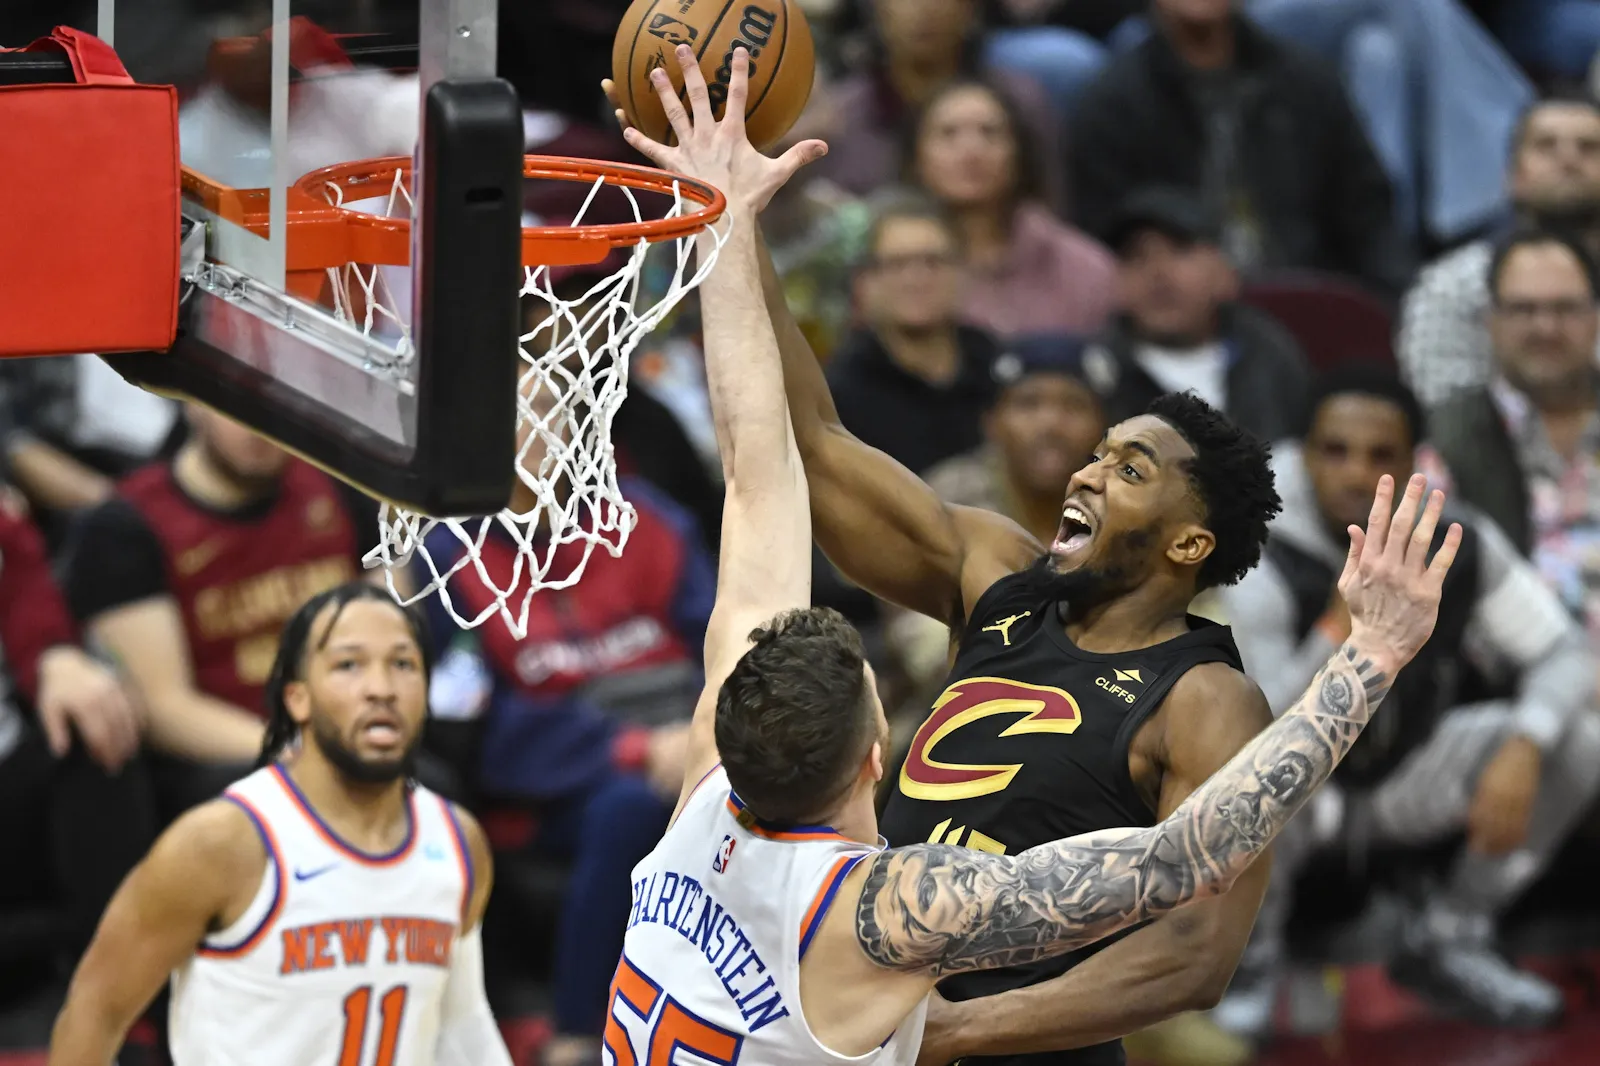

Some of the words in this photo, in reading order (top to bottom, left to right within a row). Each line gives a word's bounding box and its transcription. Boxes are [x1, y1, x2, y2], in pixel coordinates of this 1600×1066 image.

[1095, 677, 1136, 704] CLIFFS
[899, 676, 1082, 801] C
[279, 918, 374, 978] NEW
[627, 871, 791, 1033] HARTENSTEIN
[334, 983, 407, 1066] 11
